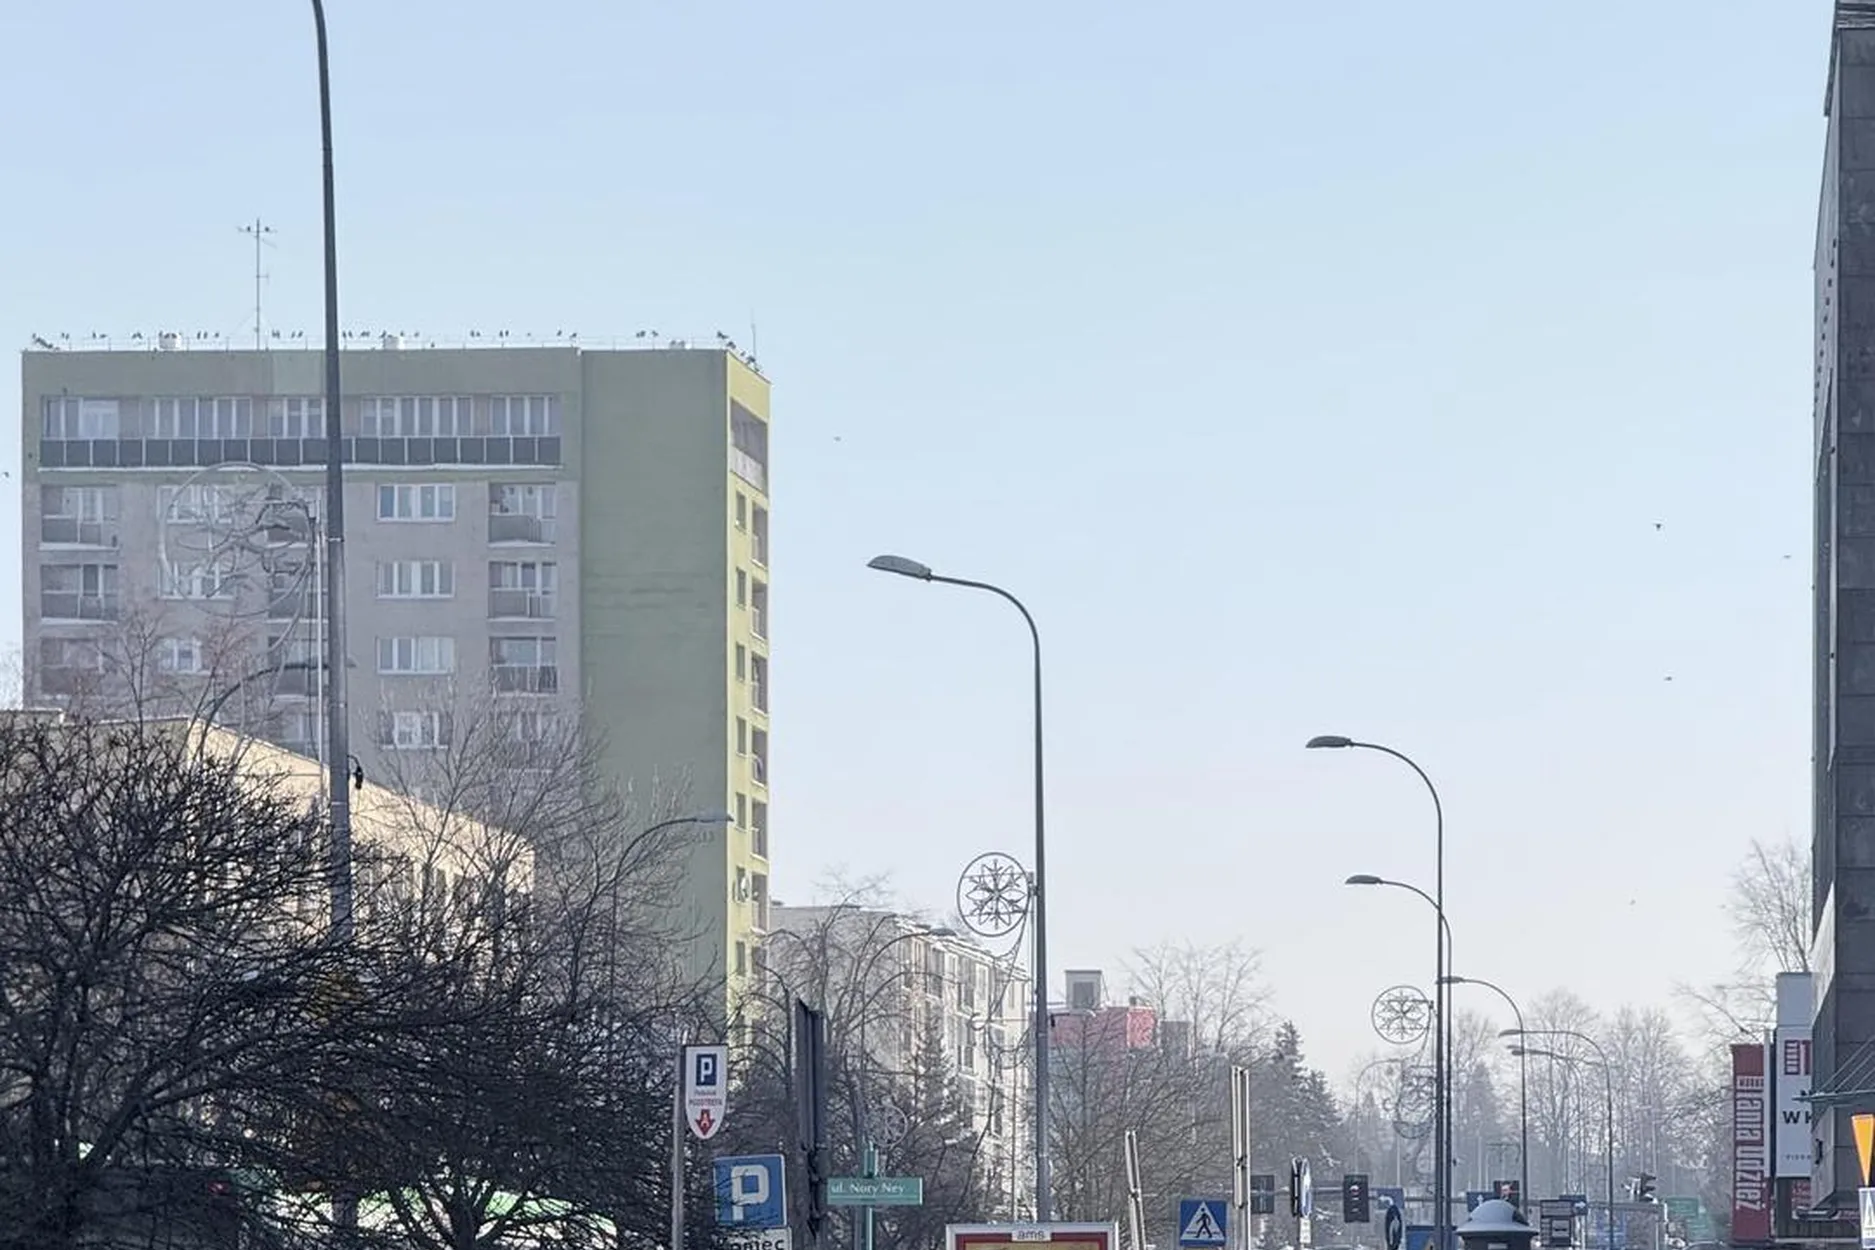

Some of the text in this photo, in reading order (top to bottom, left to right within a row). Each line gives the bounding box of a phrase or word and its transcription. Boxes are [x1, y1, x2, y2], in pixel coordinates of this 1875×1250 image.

[700, 1057, 714, 1084] P
[730, 1165, 770, 1221] P
[831, 1182, 845, 1193] ul.
[1016, 1230, 1045, 1240] ams
